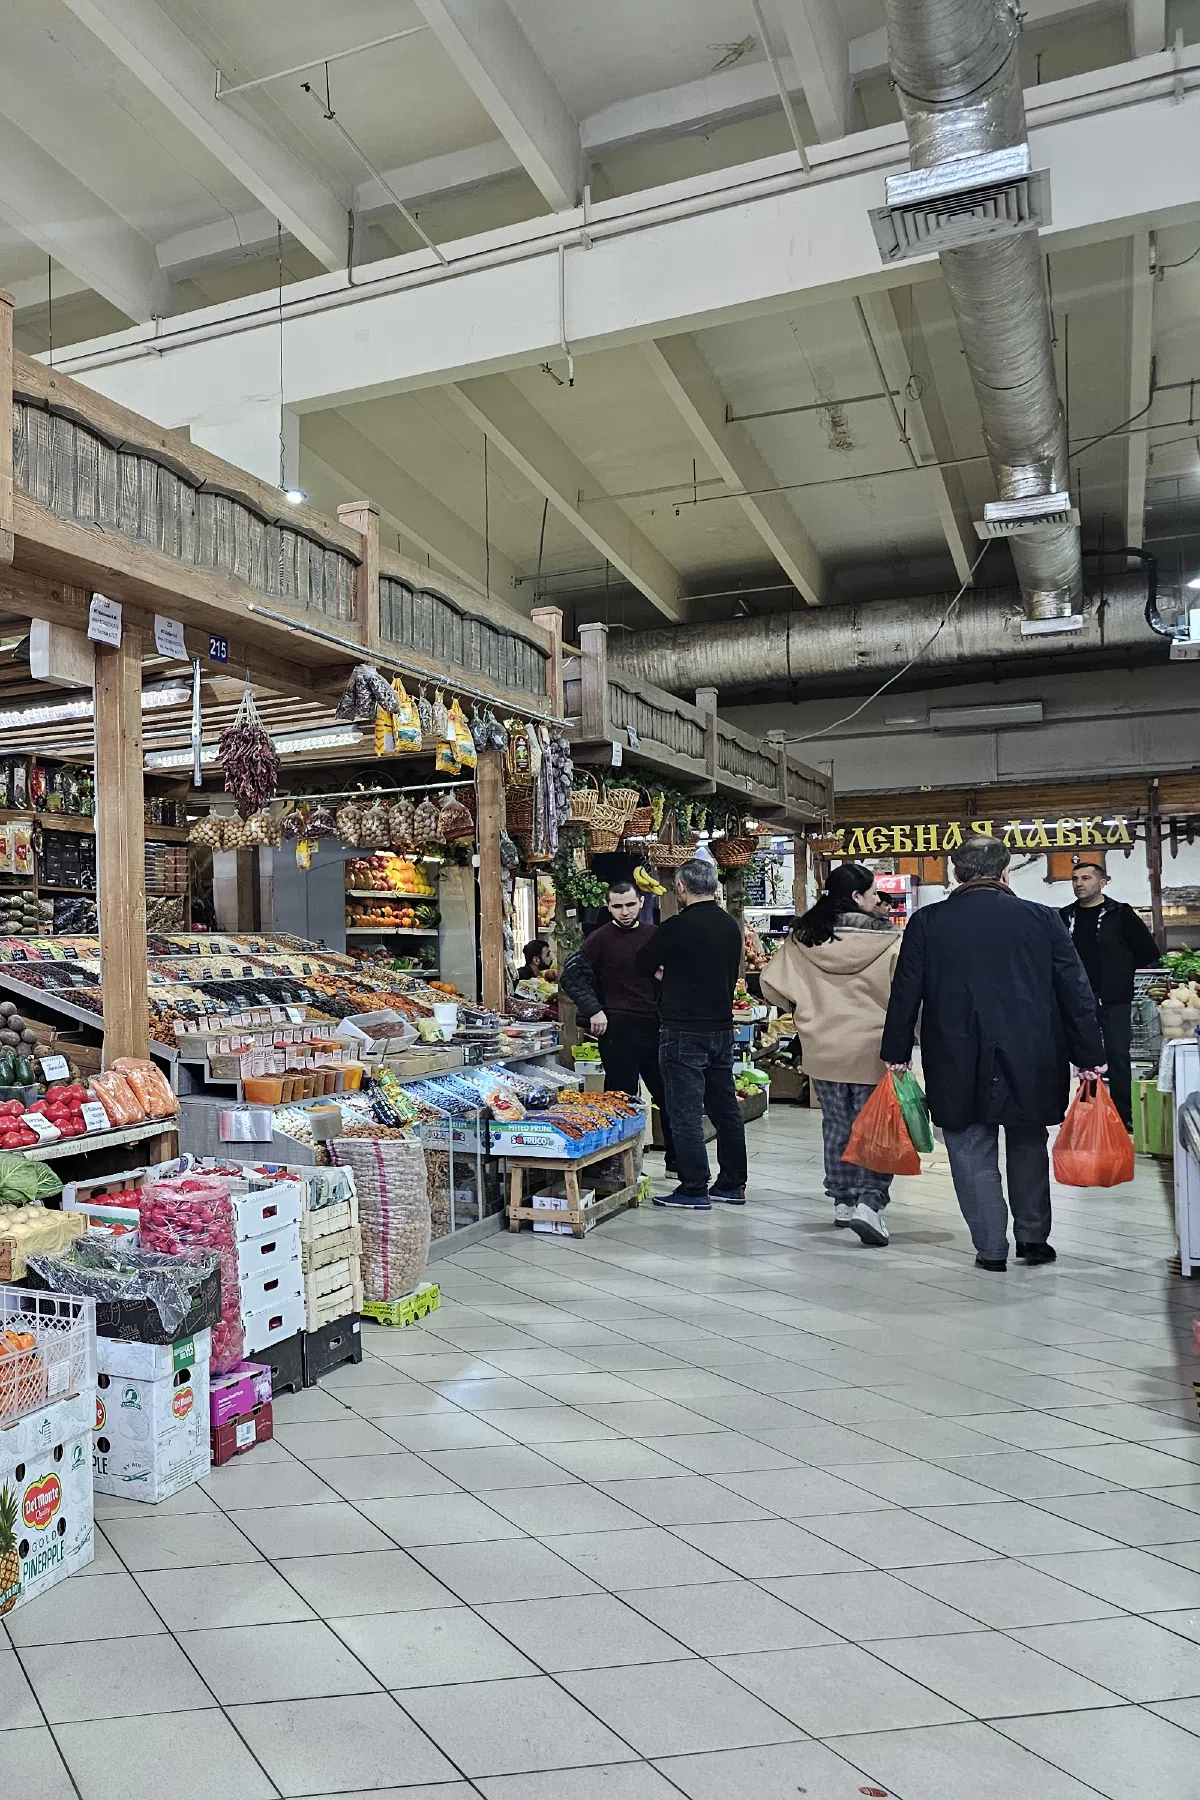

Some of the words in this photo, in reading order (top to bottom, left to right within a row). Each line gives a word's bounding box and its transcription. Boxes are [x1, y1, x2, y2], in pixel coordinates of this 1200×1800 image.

[210, 638, 228, 658] 215
[1002, 814, 1133, 849] ЛАВКА
[508, 1124, 529, 1133] PITTED
[25, 1497, 37, 1515] Del
[37, 1487, 60, 1508] Monte
[31, 1530, 58, 1553] GOLD
[23, 1540, 65, 1583] PINEAPPLE
